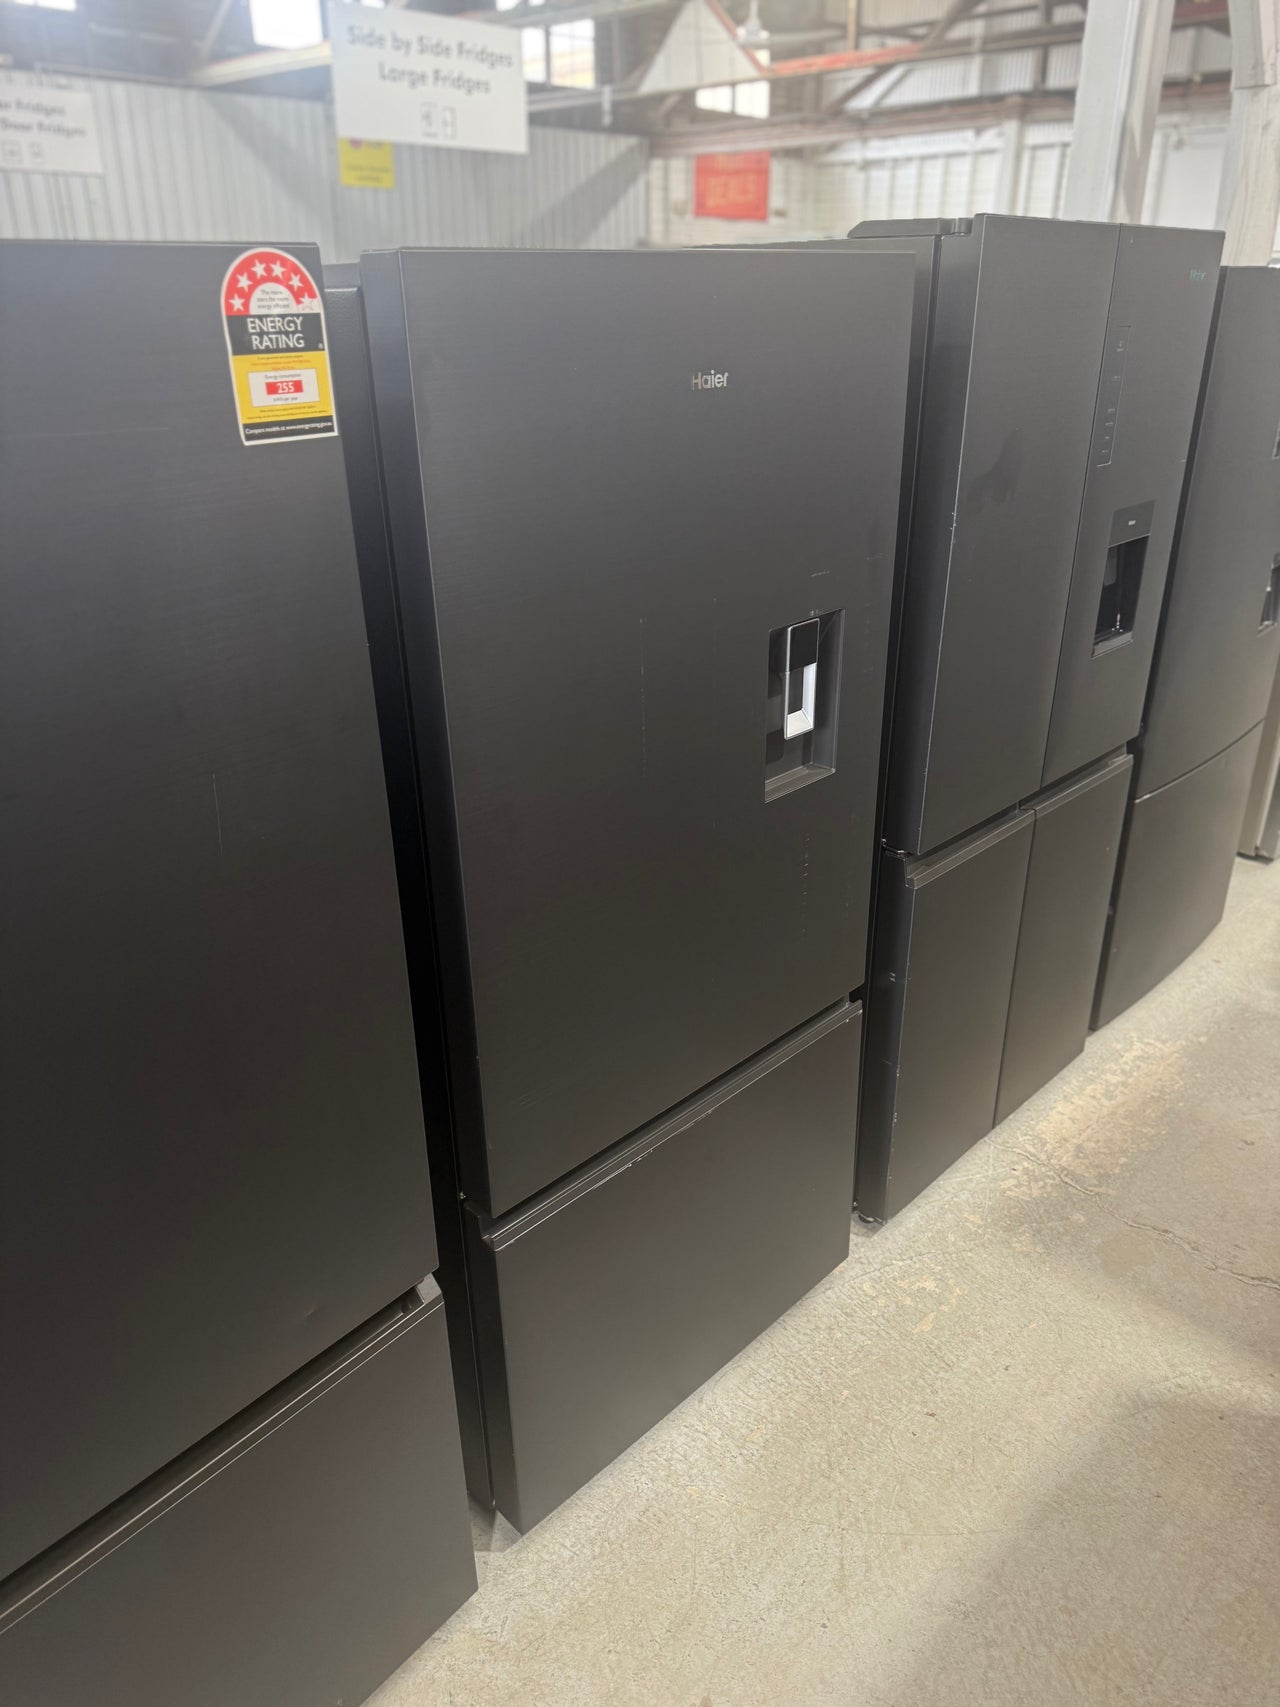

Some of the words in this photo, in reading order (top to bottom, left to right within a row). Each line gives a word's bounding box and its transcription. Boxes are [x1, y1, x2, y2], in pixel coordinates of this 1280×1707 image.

[346, 24, 385, 49] Side
[390, 31, 412, 57] by
[417, 34, 453, 59] Side
[457, 41, 514, 69] Fridges
[378, 61, 428, 89] Large
[432, 68, 492, 96] Fridges
[246, 316, 303, 333] ENERGY
[251, 333, 305, 350] RATING
[276, 382, 295, 394] 255
[692, 370, 729, 390] Haier
